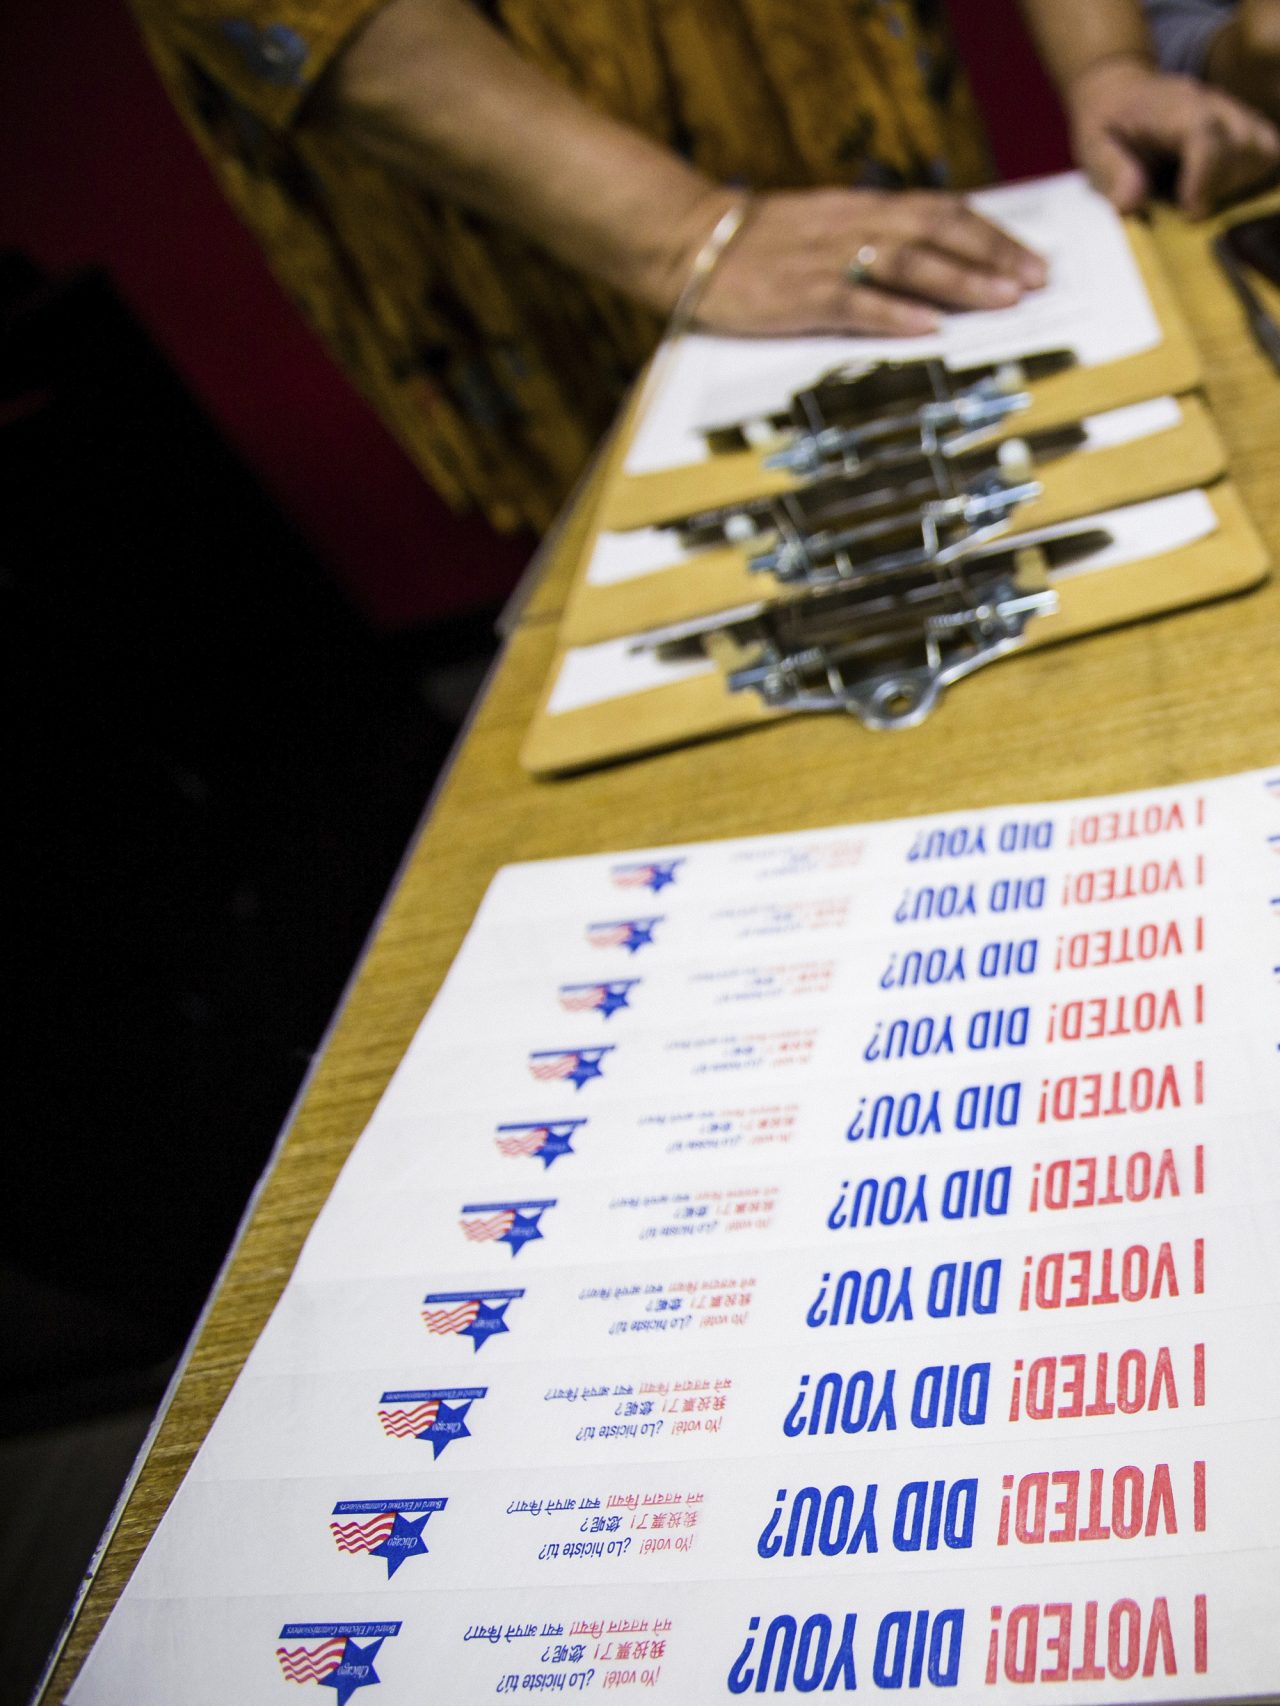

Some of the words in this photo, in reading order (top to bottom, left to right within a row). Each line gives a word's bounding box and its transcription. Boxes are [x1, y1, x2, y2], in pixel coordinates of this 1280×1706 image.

[978, 938, 1039, 979] DID
[1055, 920, 1183, 971] VOTED!
[1195, 917, 1204, 952] I
[880, 947, 967, 990] YOU?
[966, 1005, 1031, 1051] DID
[1047, 988, 1182, 1044] VOTED!
[1195, 983, 1204, 1024] I
[864, 1014, 956, 1062] YOU?
[953, 1081, 1022, 1133] DID
[1039, 1064, 1181, 1124] VOTED!
[1195, 1060, 1204, 1104] I
[846, 1089, 943, 1143] YOU?
[940, 1165, 1013, 1220] DID
[1029, 1148, 1180, 1213] VOTED!
[1194, 1144, 1205, 1195] I
[826, 1173, 928, 1231] YOU?
[926, 1258, 1003, 1319] DID
[1019, 1241, 1179, 1312] VOTED!
[1193, 1237, 1205, 1295] I
[805, 1265, 914, 1328] YOU?
[910, 1361, 992, 1429] DID
[1008, 1346, 1179, 1422] VOTED!
[1193, 1343, 1205, 1407] I
[783, 1368, 897, 1438] YOU?
[757, 1483, 879, 1559] YOU?
[892, 1477, 979, 1552] DID
[997, 1463, 1179, 1547] VOTED!
[1193, 1460, 1206, 1532] I
[388, 1535, 418, 1548] Chicago
[538, 1543, 561, 1560] tú?
[560, 1542, 605, 1558] hiciste
[607, 1536, 632, 1555] ¿Lo
[640, 1537, 672, 1552] voté!
[286, 1626, 338, 1636] Commissioners
[339, 1626, 366, 1635] Election
[373, 1625, 396, 1634] Board
[727, 1612, 858, 1694] YOU?
[872, 1607, 966, 1689] DID
[985, 1596, 1178, 1686] VOTED!
[1194, 1593, 1208, 1674] I
[337, 1664, 369, 1677] Chicago
[496, 1674, 521, 1693] tú?
[522, 1673, 568, 1691] hiciste
[567, 1667, 596, 1691] ¿Lo
[603, 1670, 638, 1688] voté!
